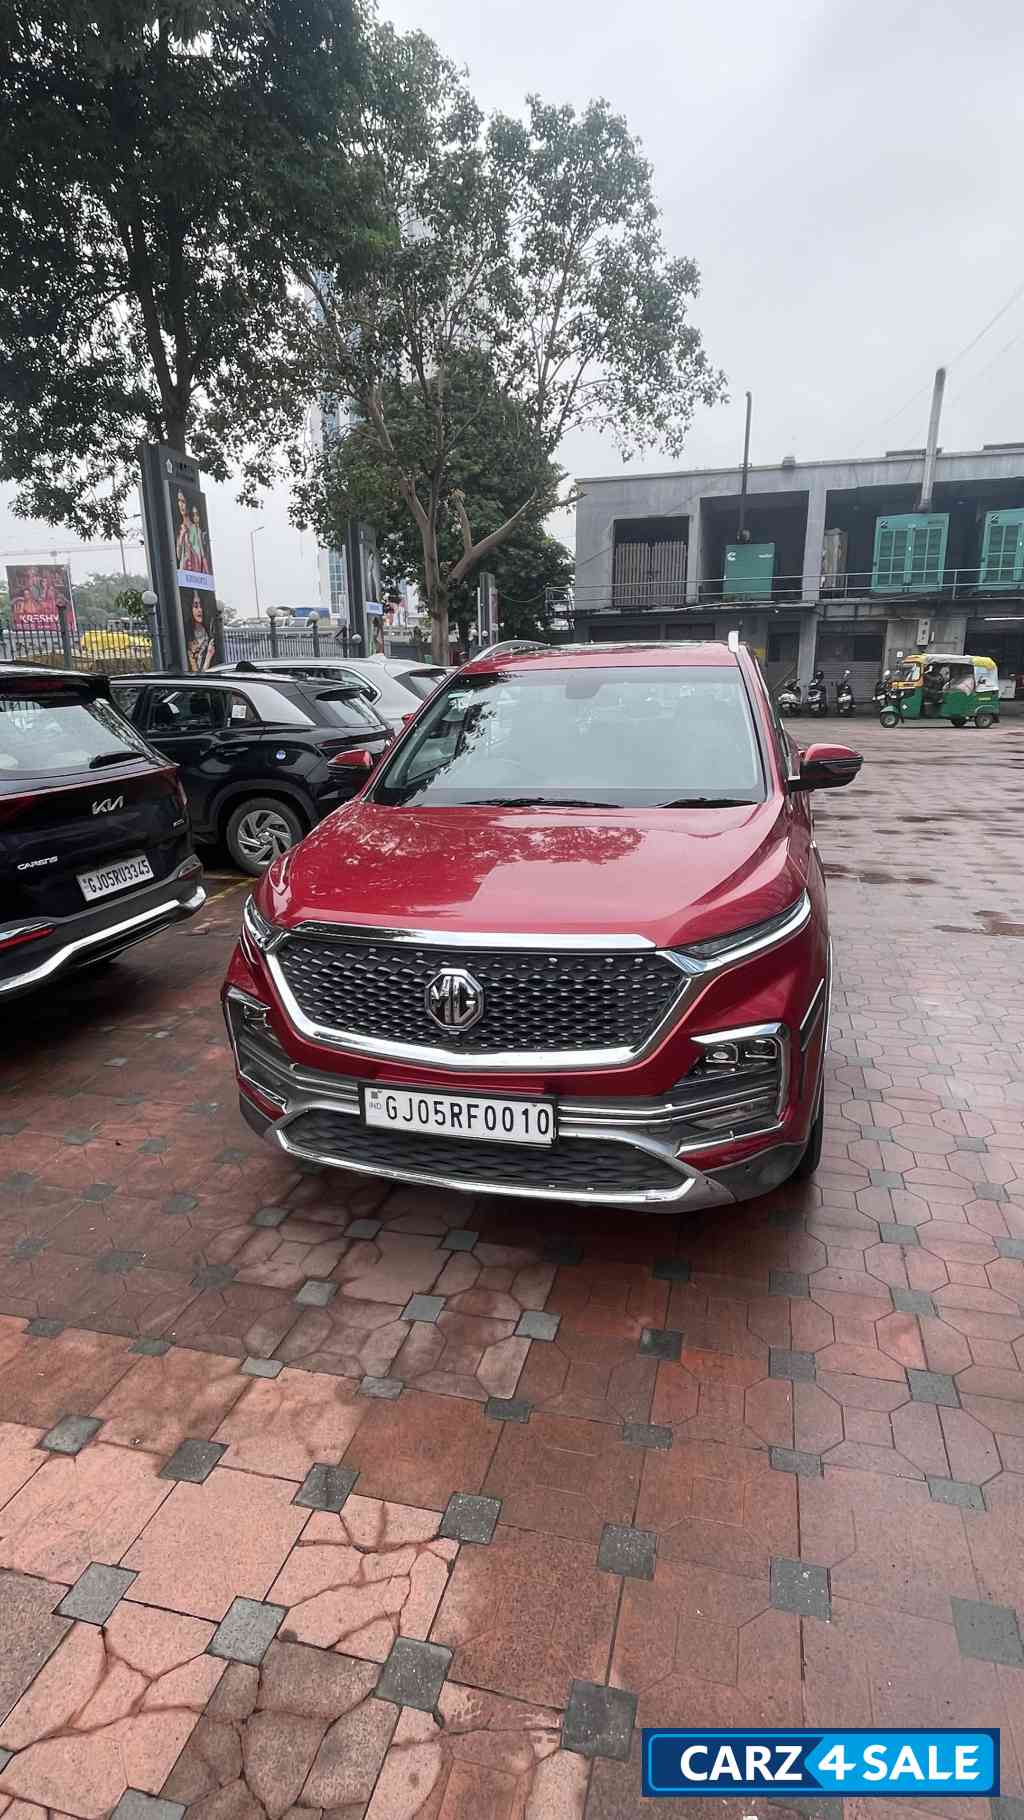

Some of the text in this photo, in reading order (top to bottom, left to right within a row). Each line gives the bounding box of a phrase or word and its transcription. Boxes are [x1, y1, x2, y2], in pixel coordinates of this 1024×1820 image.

[92, 795, 124, 815] KIA
[17, 855, 59, 870] CARENS
[88, 859, 150, 893] GJ05RU3345
[431, 975, 476, 1024] MG
[385, 1095, 549, 1135] GJ05RF0010
